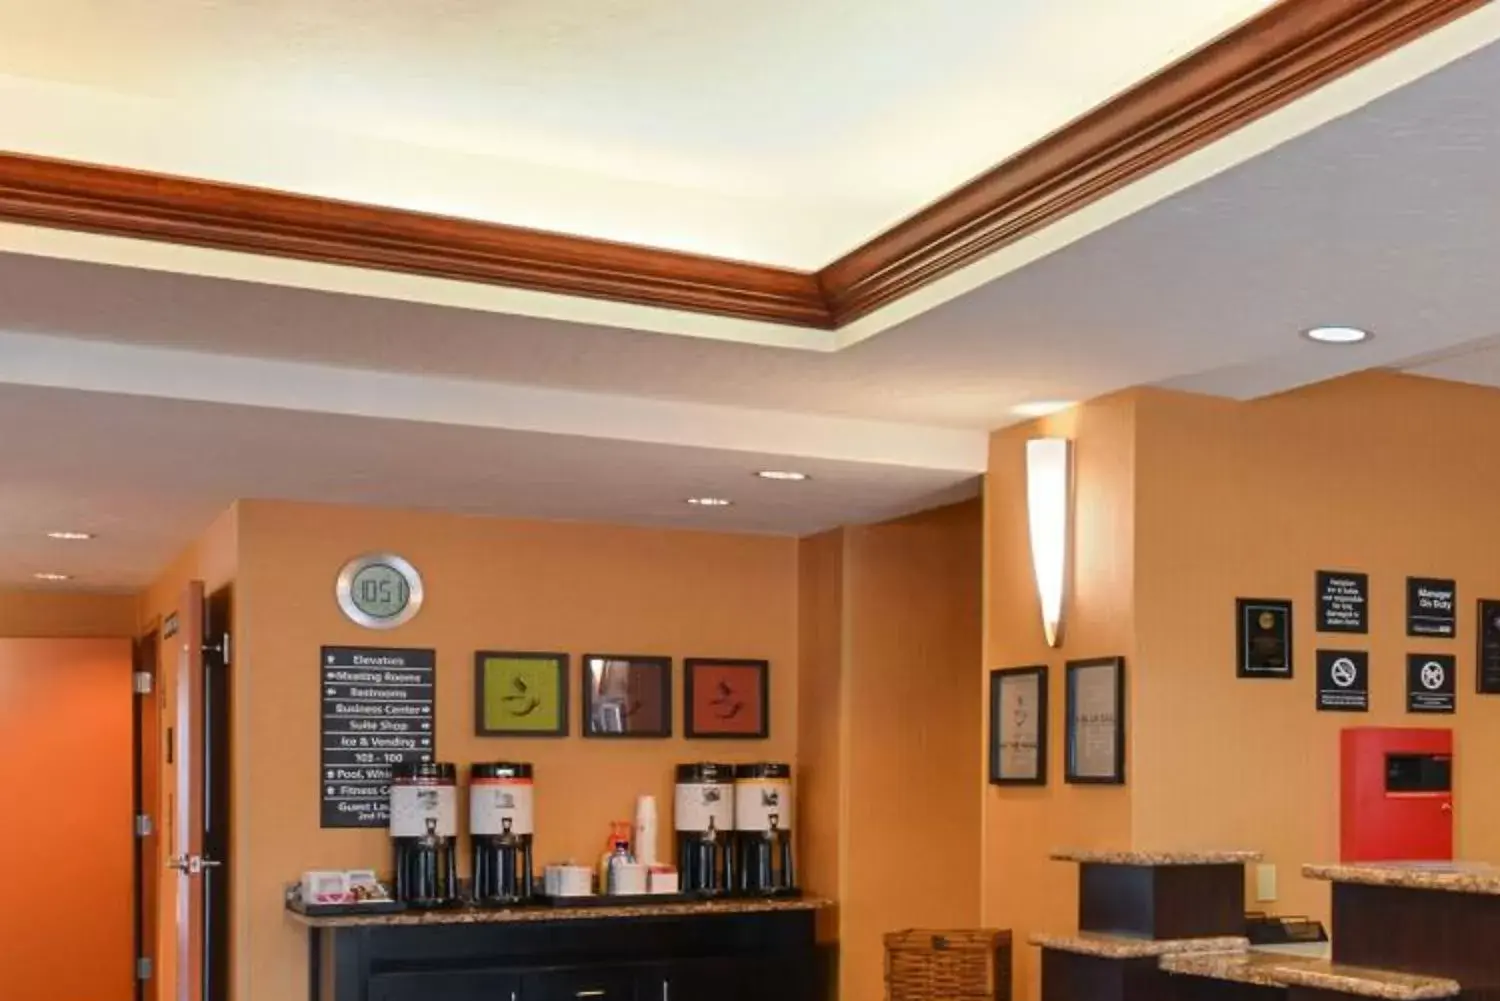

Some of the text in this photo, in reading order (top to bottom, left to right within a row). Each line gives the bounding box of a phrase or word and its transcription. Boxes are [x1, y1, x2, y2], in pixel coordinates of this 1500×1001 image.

[353, 655, 405, 666] Elevators
[350, 687, 407, 698] Restrooms
[335, 703, 420, 715] Business Center
[349, 719, 378, 731] Suite
[341, 736, 416, 749] Ice & Vending
[337, 769, 365, 780] Pool,
